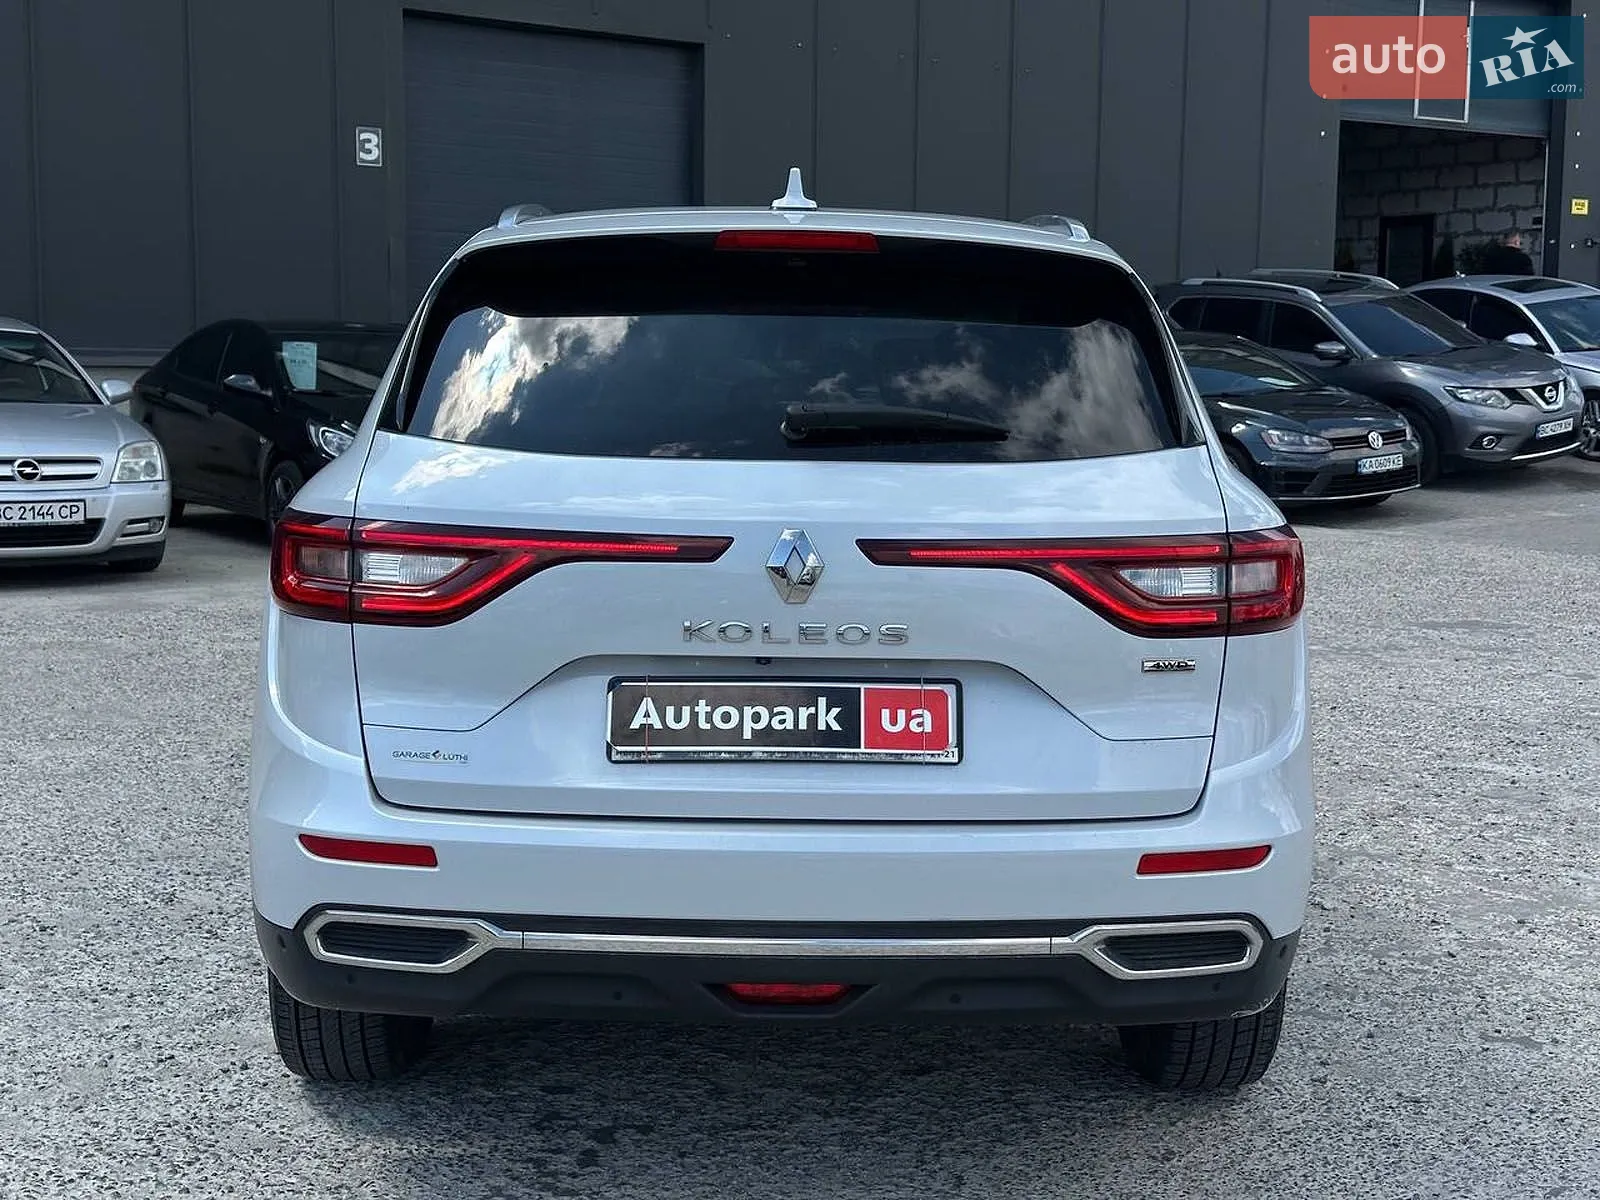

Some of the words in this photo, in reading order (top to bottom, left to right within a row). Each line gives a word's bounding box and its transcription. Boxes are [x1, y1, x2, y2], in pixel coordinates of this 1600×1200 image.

[360, 132, 379, 160] 3
[0, 505, 14, 521] C
[18, 504, 55, 521] 2144
[58, 504, 81, 519] CP
[682, 620, 910, 645] KOLEOS
[629, 697, 843, 740] Autopark
[880, 706, 933, 733] ua
[392, 750, 431, 760] GARAGE
